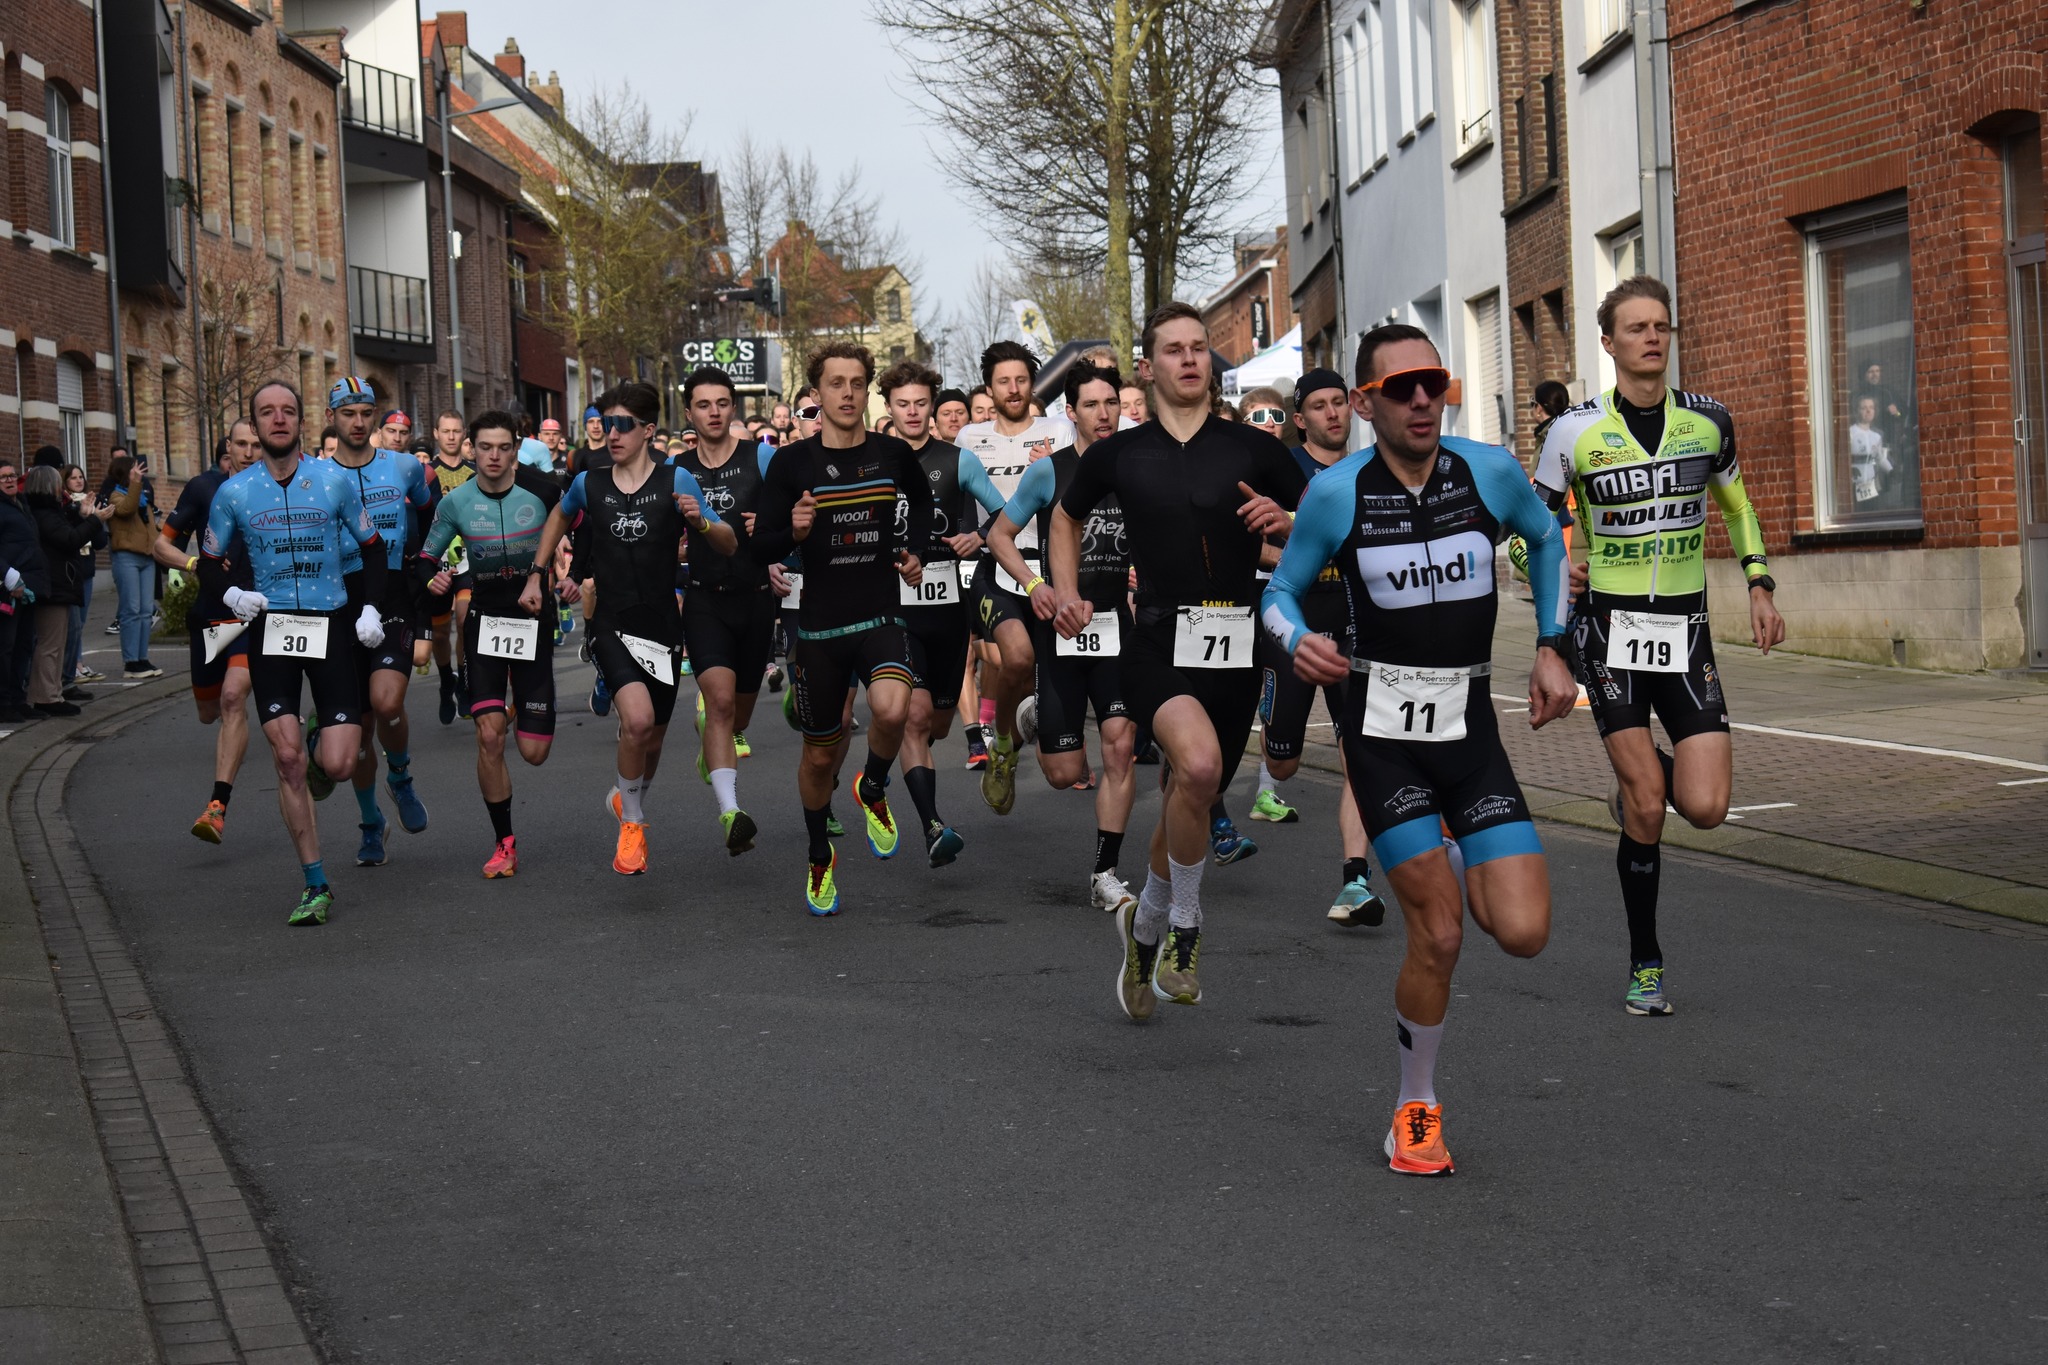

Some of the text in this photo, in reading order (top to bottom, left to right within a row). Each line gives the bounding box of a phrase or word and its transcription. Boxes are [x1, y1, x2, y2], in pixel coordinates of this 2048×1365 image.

[1574, 409, 1601, 417] PROJECTS
[1668, 447, 1707, 456] CAMMAERT
[1679, 440, 1700, 448] IVECO
[1440, 485, 1469, 500] Dhulster
[1427, 496, 1439, 505] Rik
[832, 504, 875, 524] woon!
[1601, 498, 1703, 527] INDULEK
[1680, 514, 1704, 524] PROJECTS
[831, 530, 879, 546] EL POZO
[1362, 526, 1412, 535] BOUSSEMAERE
[275, 544, 325, 554] BIKESTORE
[1602, 533, 1702, 558] DERITO
[1084, 554, 1122, 562] Ateljee
[1645, 557, 1652, 565] &
[1662, 554, 1695, 564] Deuren
[1386, 551, 1476, 591] vind!
[914, 581, 948, 601] 102
[1646, 618, 1680, 626] Peperstraat
[283, 635, 308, 652] 30
[491, 635, 525, 655] 112
[1076, 633, 1101, 652] 98
[1203, 635, 1231, 662] 71
[1626, 638, 1671, 666] 119
[1403, 673, 1461, 683] De Peperstraat
[1399, 700, 1436, 734] 11
[1400, 792, 1427, 804] GOUDEN
[1396, 799, 1431, 815] MANDEKEN
[1478, 800, 1509, 813] GOUDEN
[1471, 807, 1512, 824] MANDEKEN
